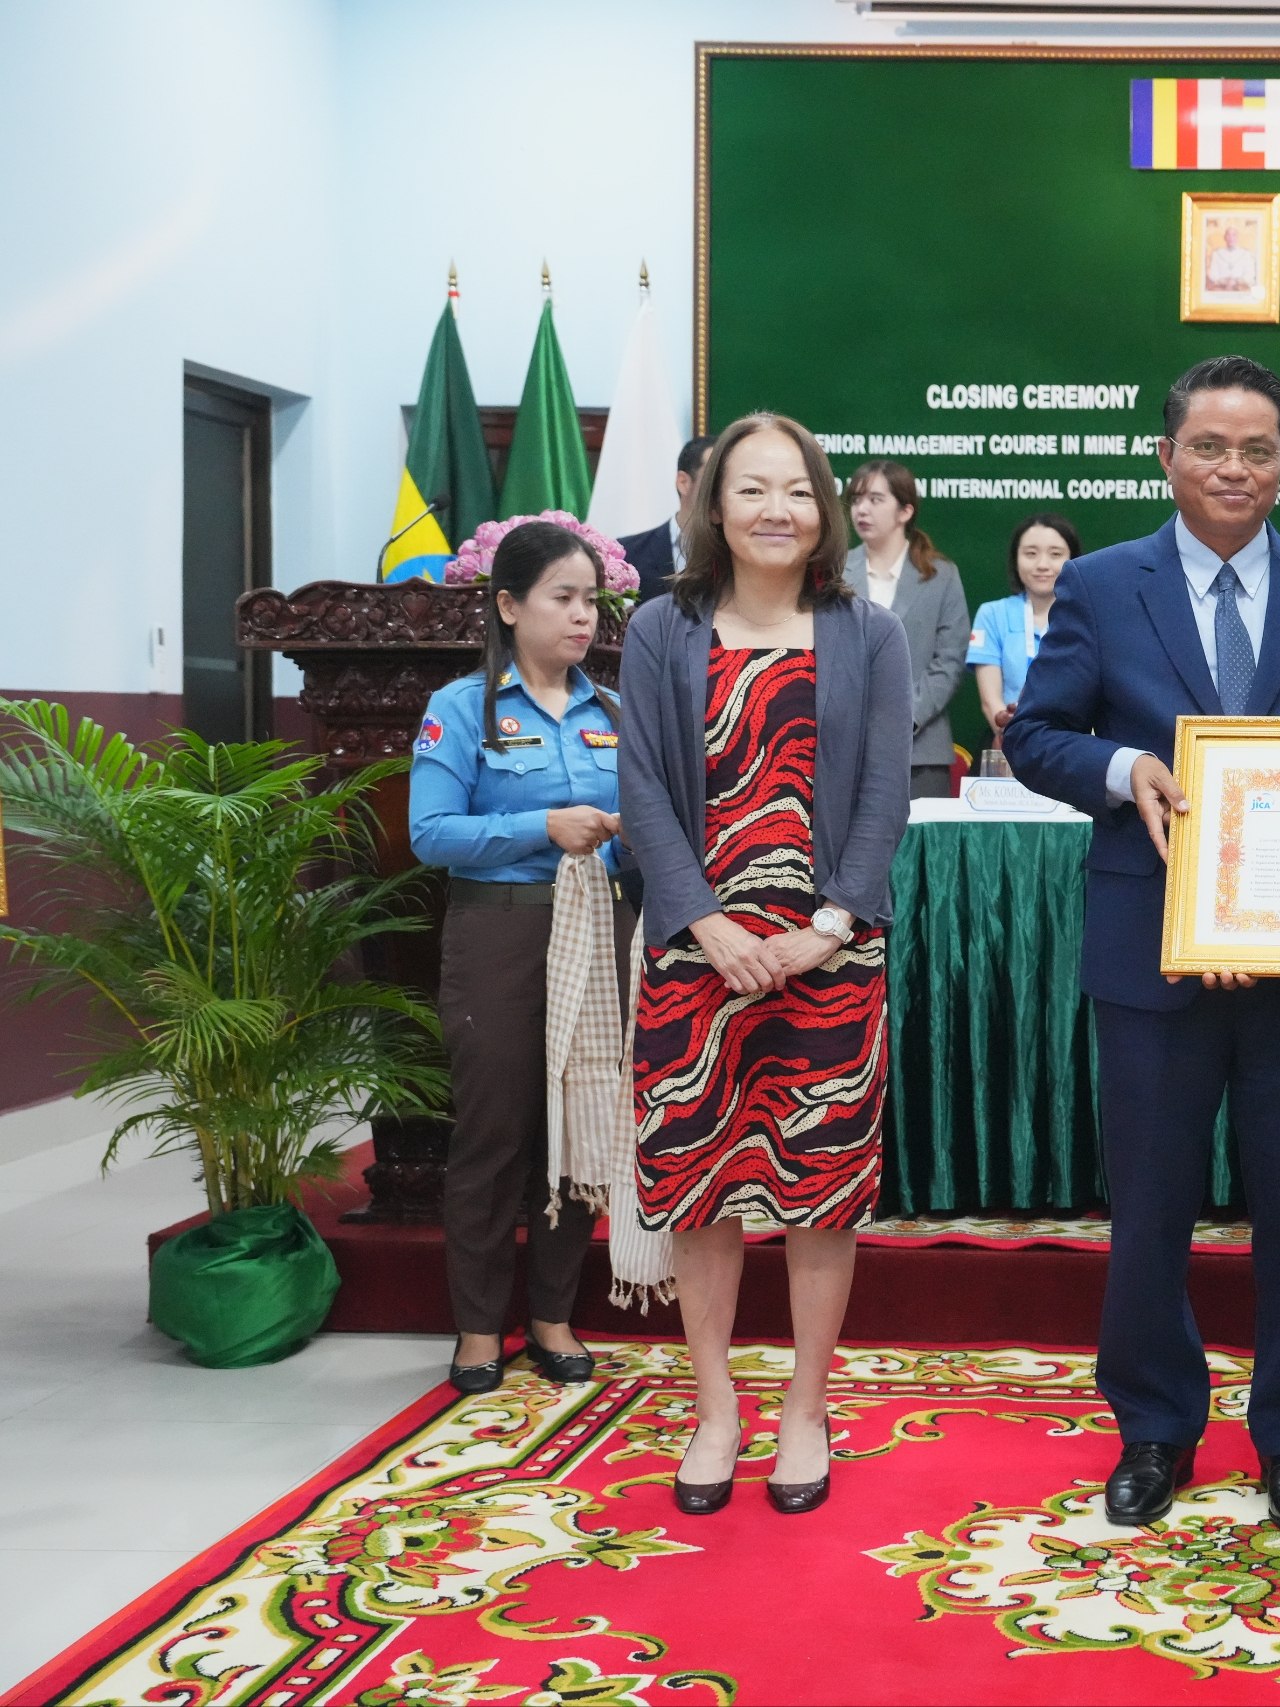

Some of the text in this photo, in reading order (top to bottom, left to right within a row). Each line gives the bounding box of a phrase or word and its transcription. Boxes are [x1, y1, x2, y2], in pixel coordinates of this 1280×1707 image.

[926, 384, 1139, 410] CLOSING CEREMONY
[814, 433, 1166, 456] ENIOR MANAGEMENT COURSE IN MINE ACT
[930, 478, 1064, 499] INTERNATIONAL
[1066, 479, 1175, 500] COOPERATI
